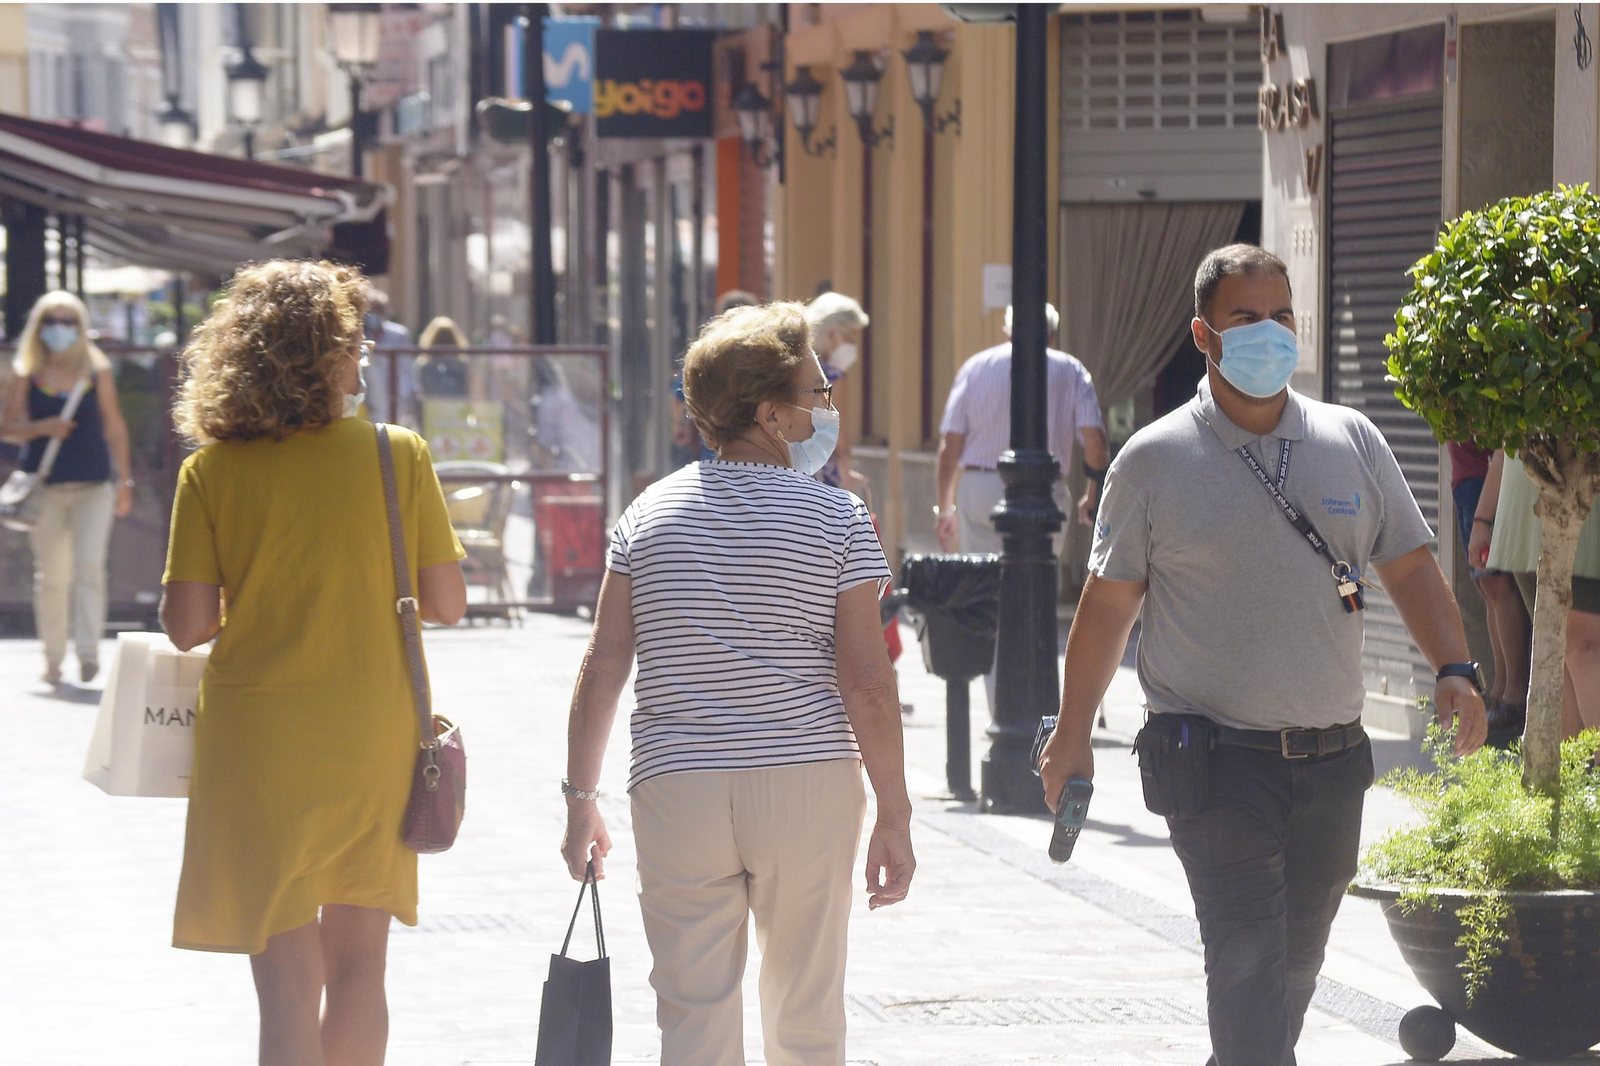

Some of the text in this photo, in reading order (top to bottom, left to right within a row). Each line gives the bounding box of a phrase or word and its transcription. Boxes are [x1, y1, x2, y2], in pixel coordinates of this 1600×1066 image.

[595, 78, 705, 119] yoigo
[1321, 497, 1351, 507] Johnson
[1327, 506, 1357, 516] Controls
